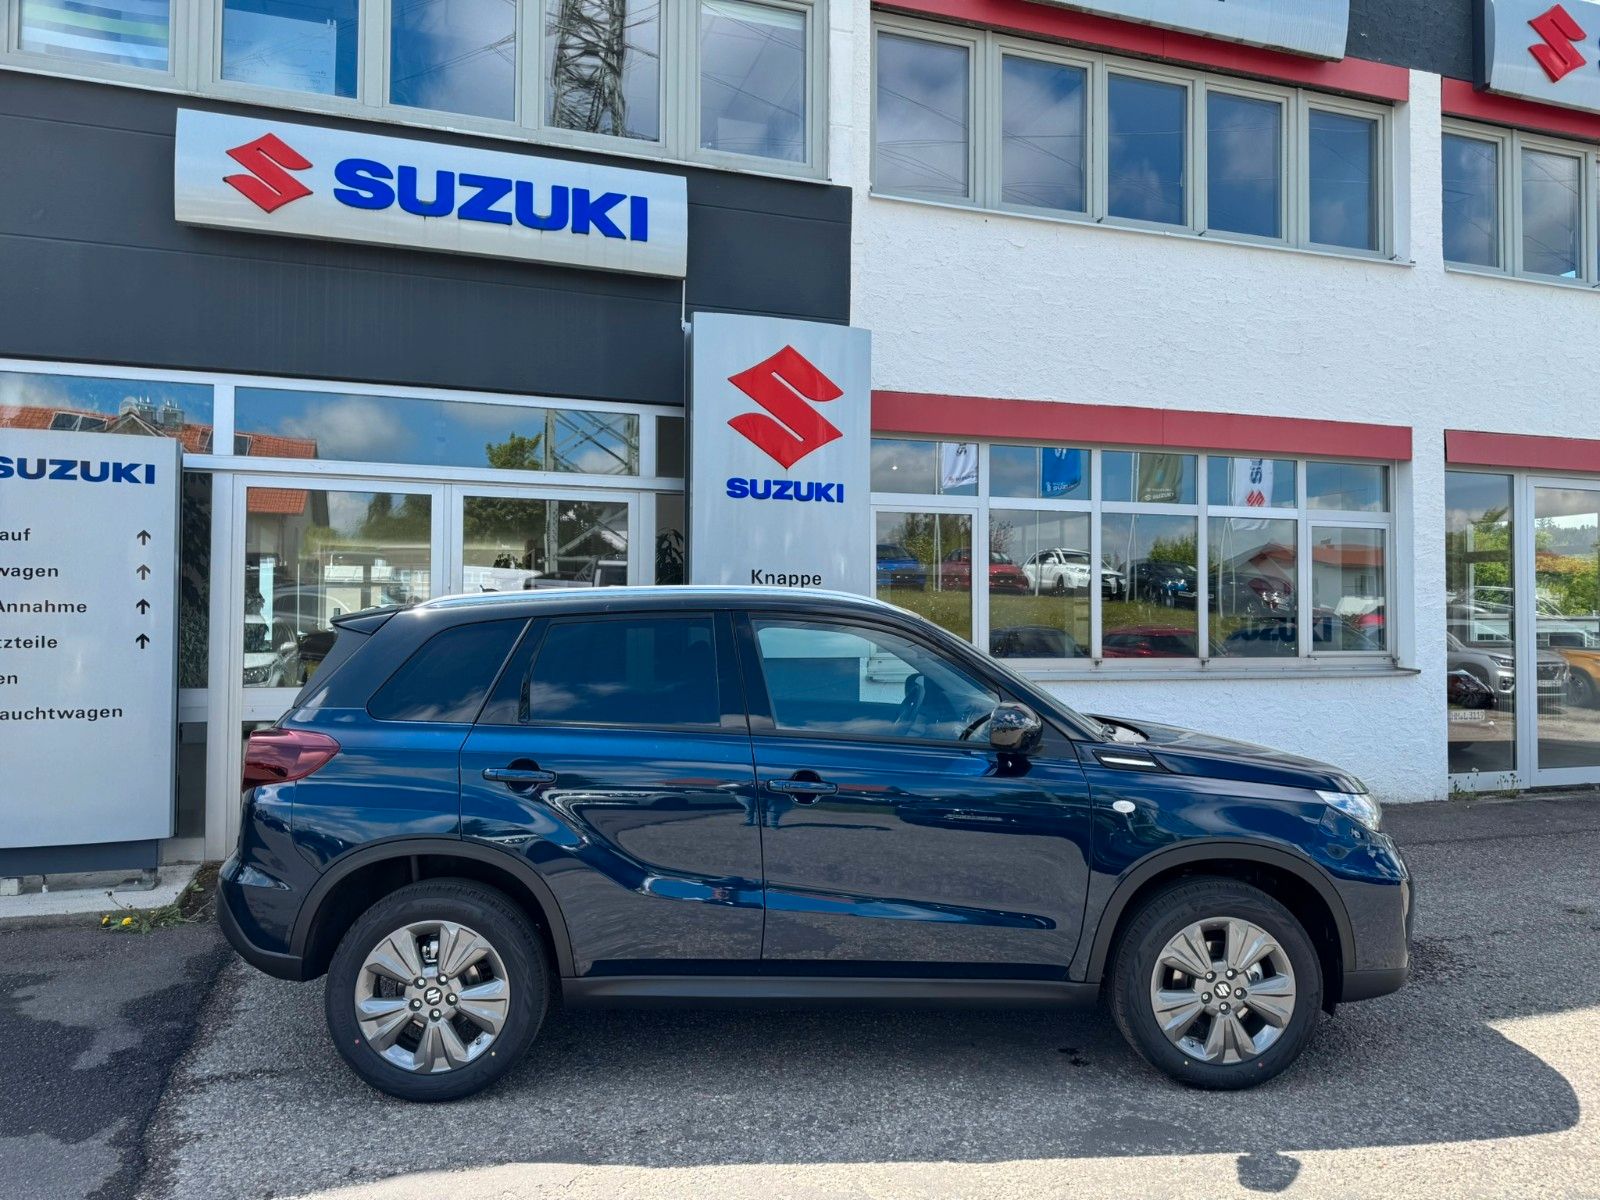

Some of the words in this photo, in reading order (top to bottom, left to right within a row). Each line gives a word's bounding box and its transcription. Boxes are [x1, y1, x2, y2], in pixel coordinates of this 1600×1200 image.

[333, 158, 648, 242] SUZUKI
[726, 477, 844, 503] SUZUKI
[751, 569, 822, 588] Knappe
[0, 707, 123, 721] auchtwagen
